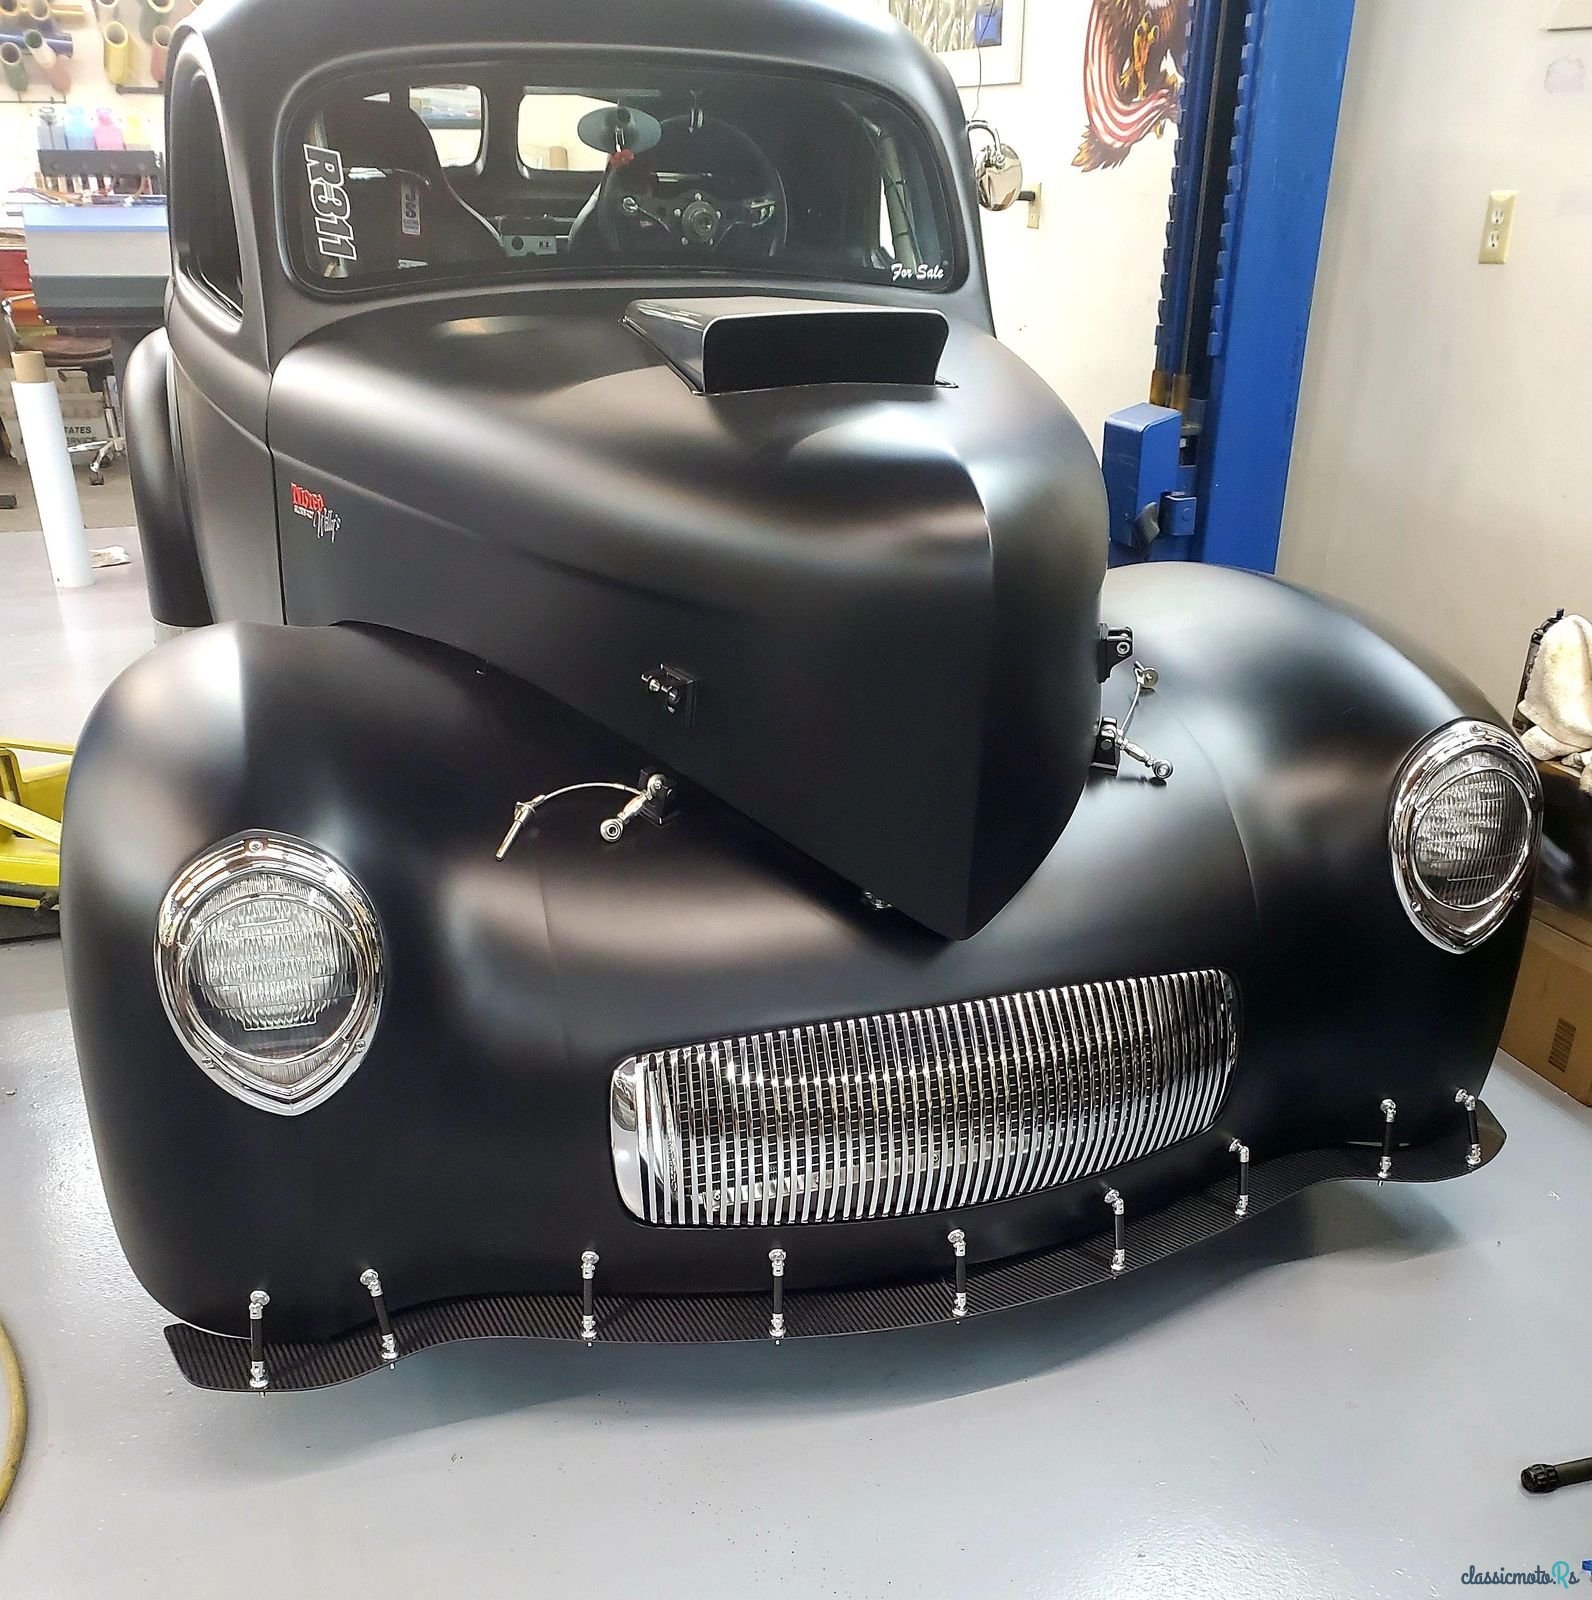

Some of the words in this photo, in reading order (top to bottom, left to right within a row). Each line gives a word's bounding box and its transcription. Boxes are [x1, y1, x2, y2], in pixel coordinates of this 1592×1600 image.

[303, 143, 357, 260] R311
[891, 263, 912, 281] For
[916, 264, 944, 280] Sale
[64, 426, 92, 434] TATES
